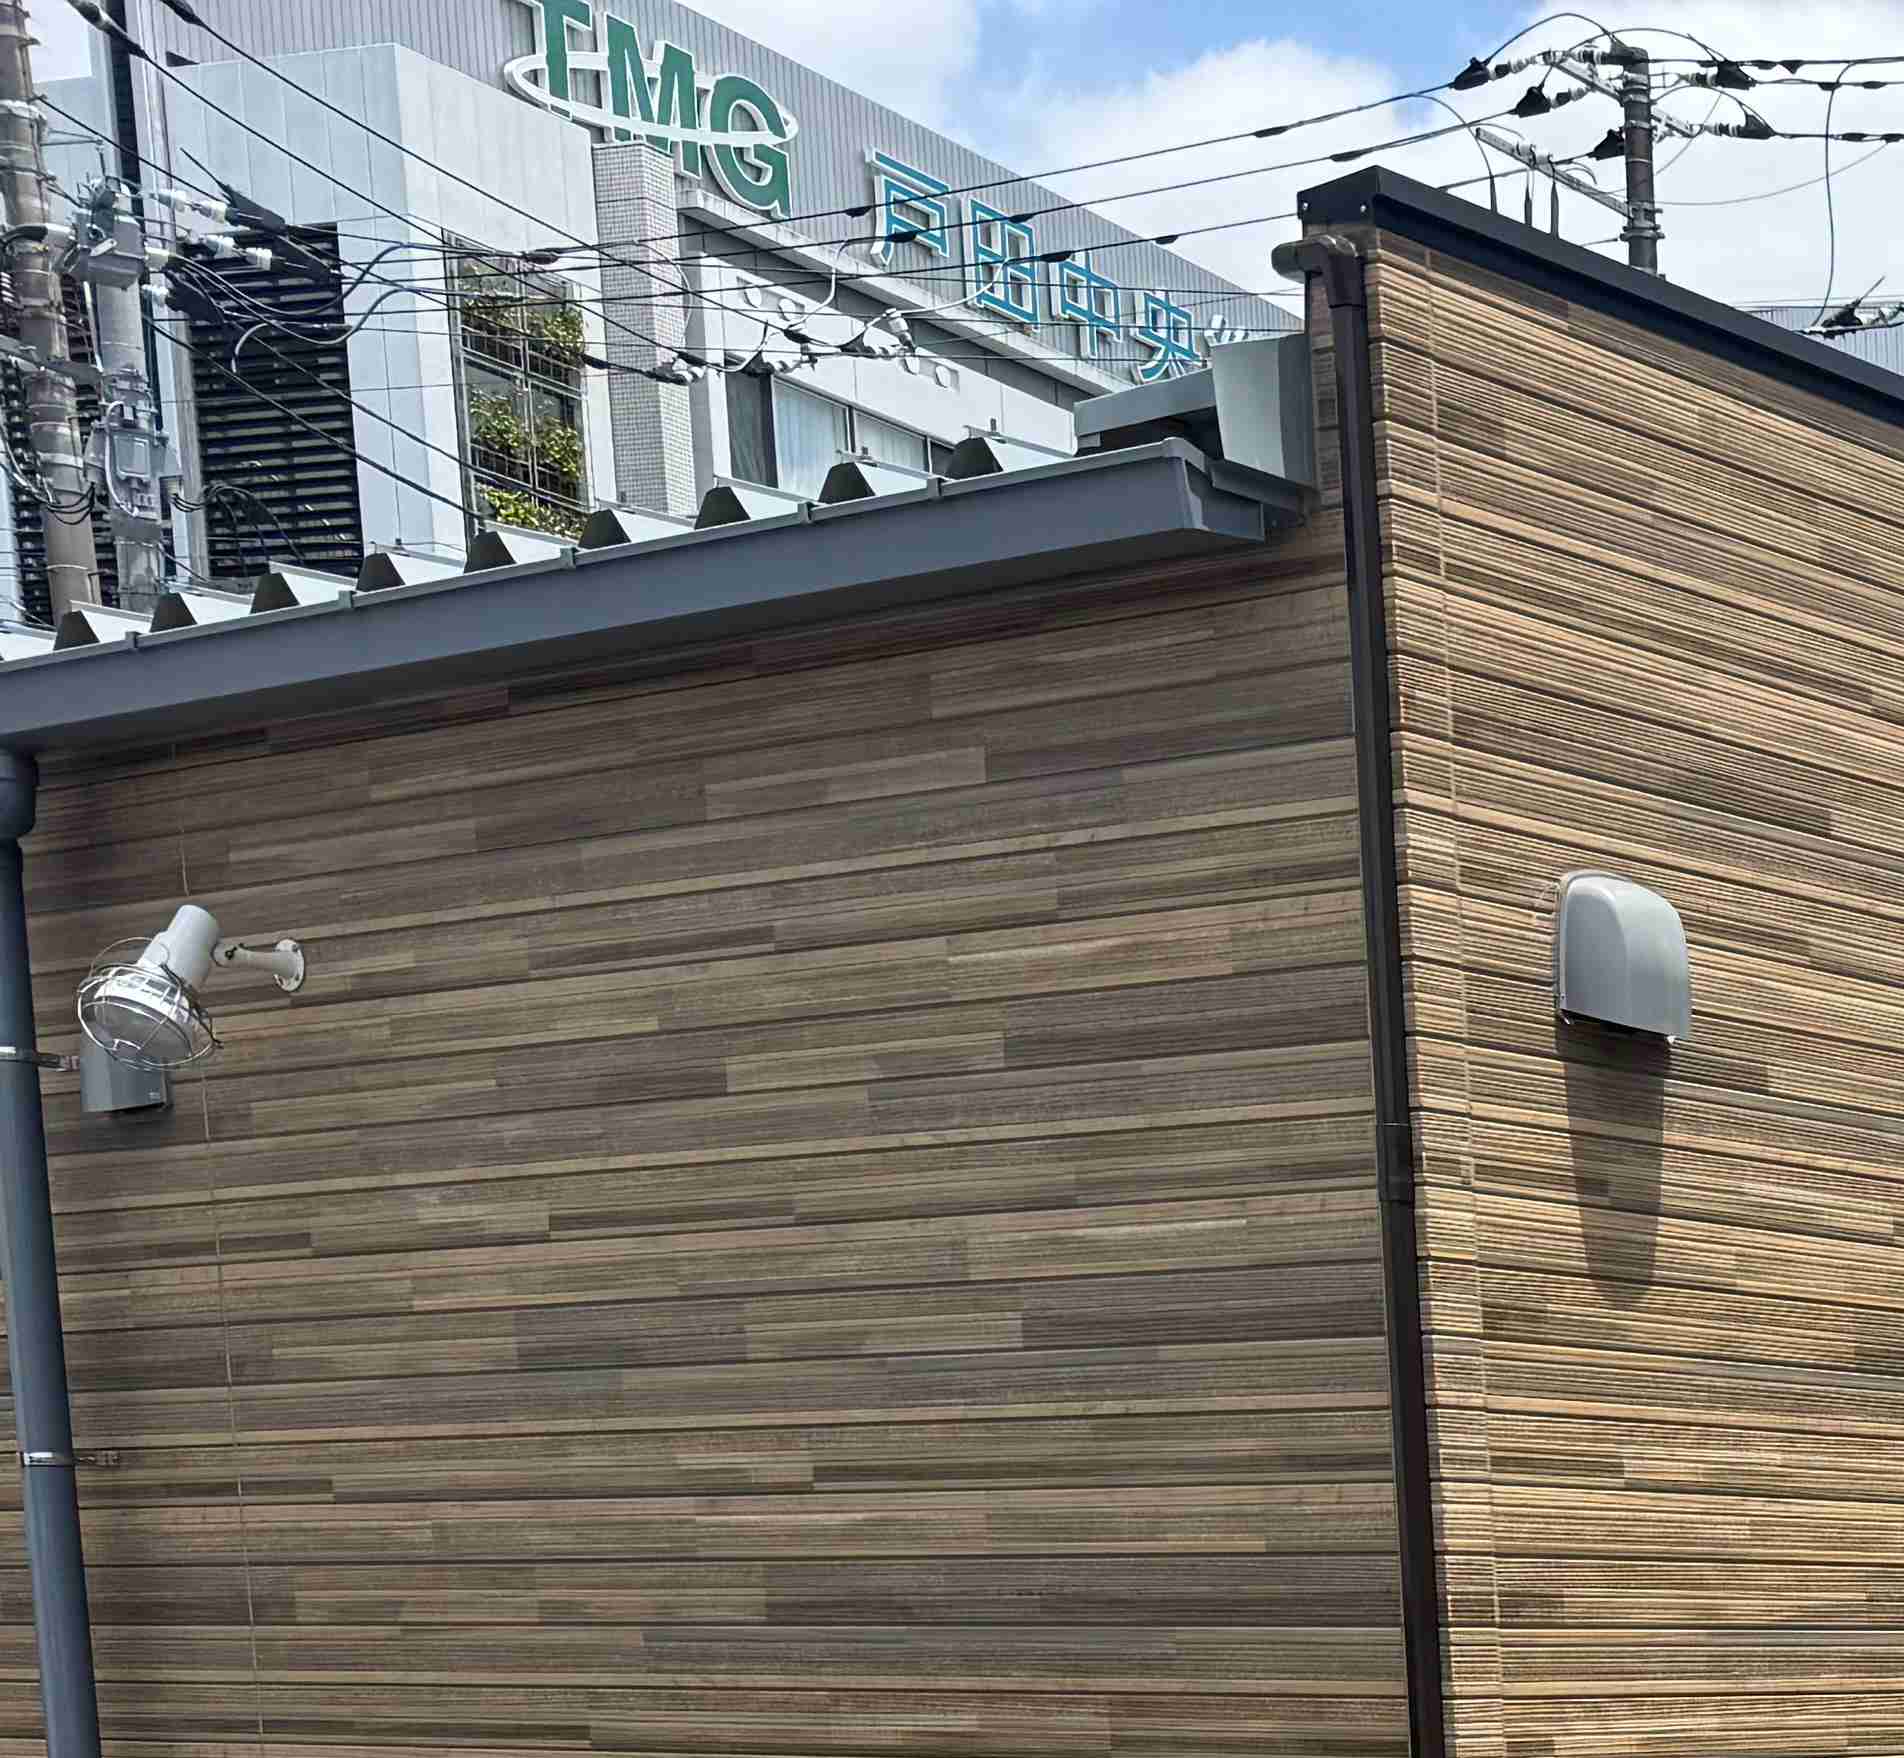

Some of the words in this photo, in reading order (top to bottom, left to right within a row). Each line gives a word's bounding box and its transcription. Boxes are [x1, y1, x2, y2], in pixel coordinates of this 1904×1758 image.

[540, 0, 794, 219] TMG
[868, 148, 1248, 384] 戸田中央
